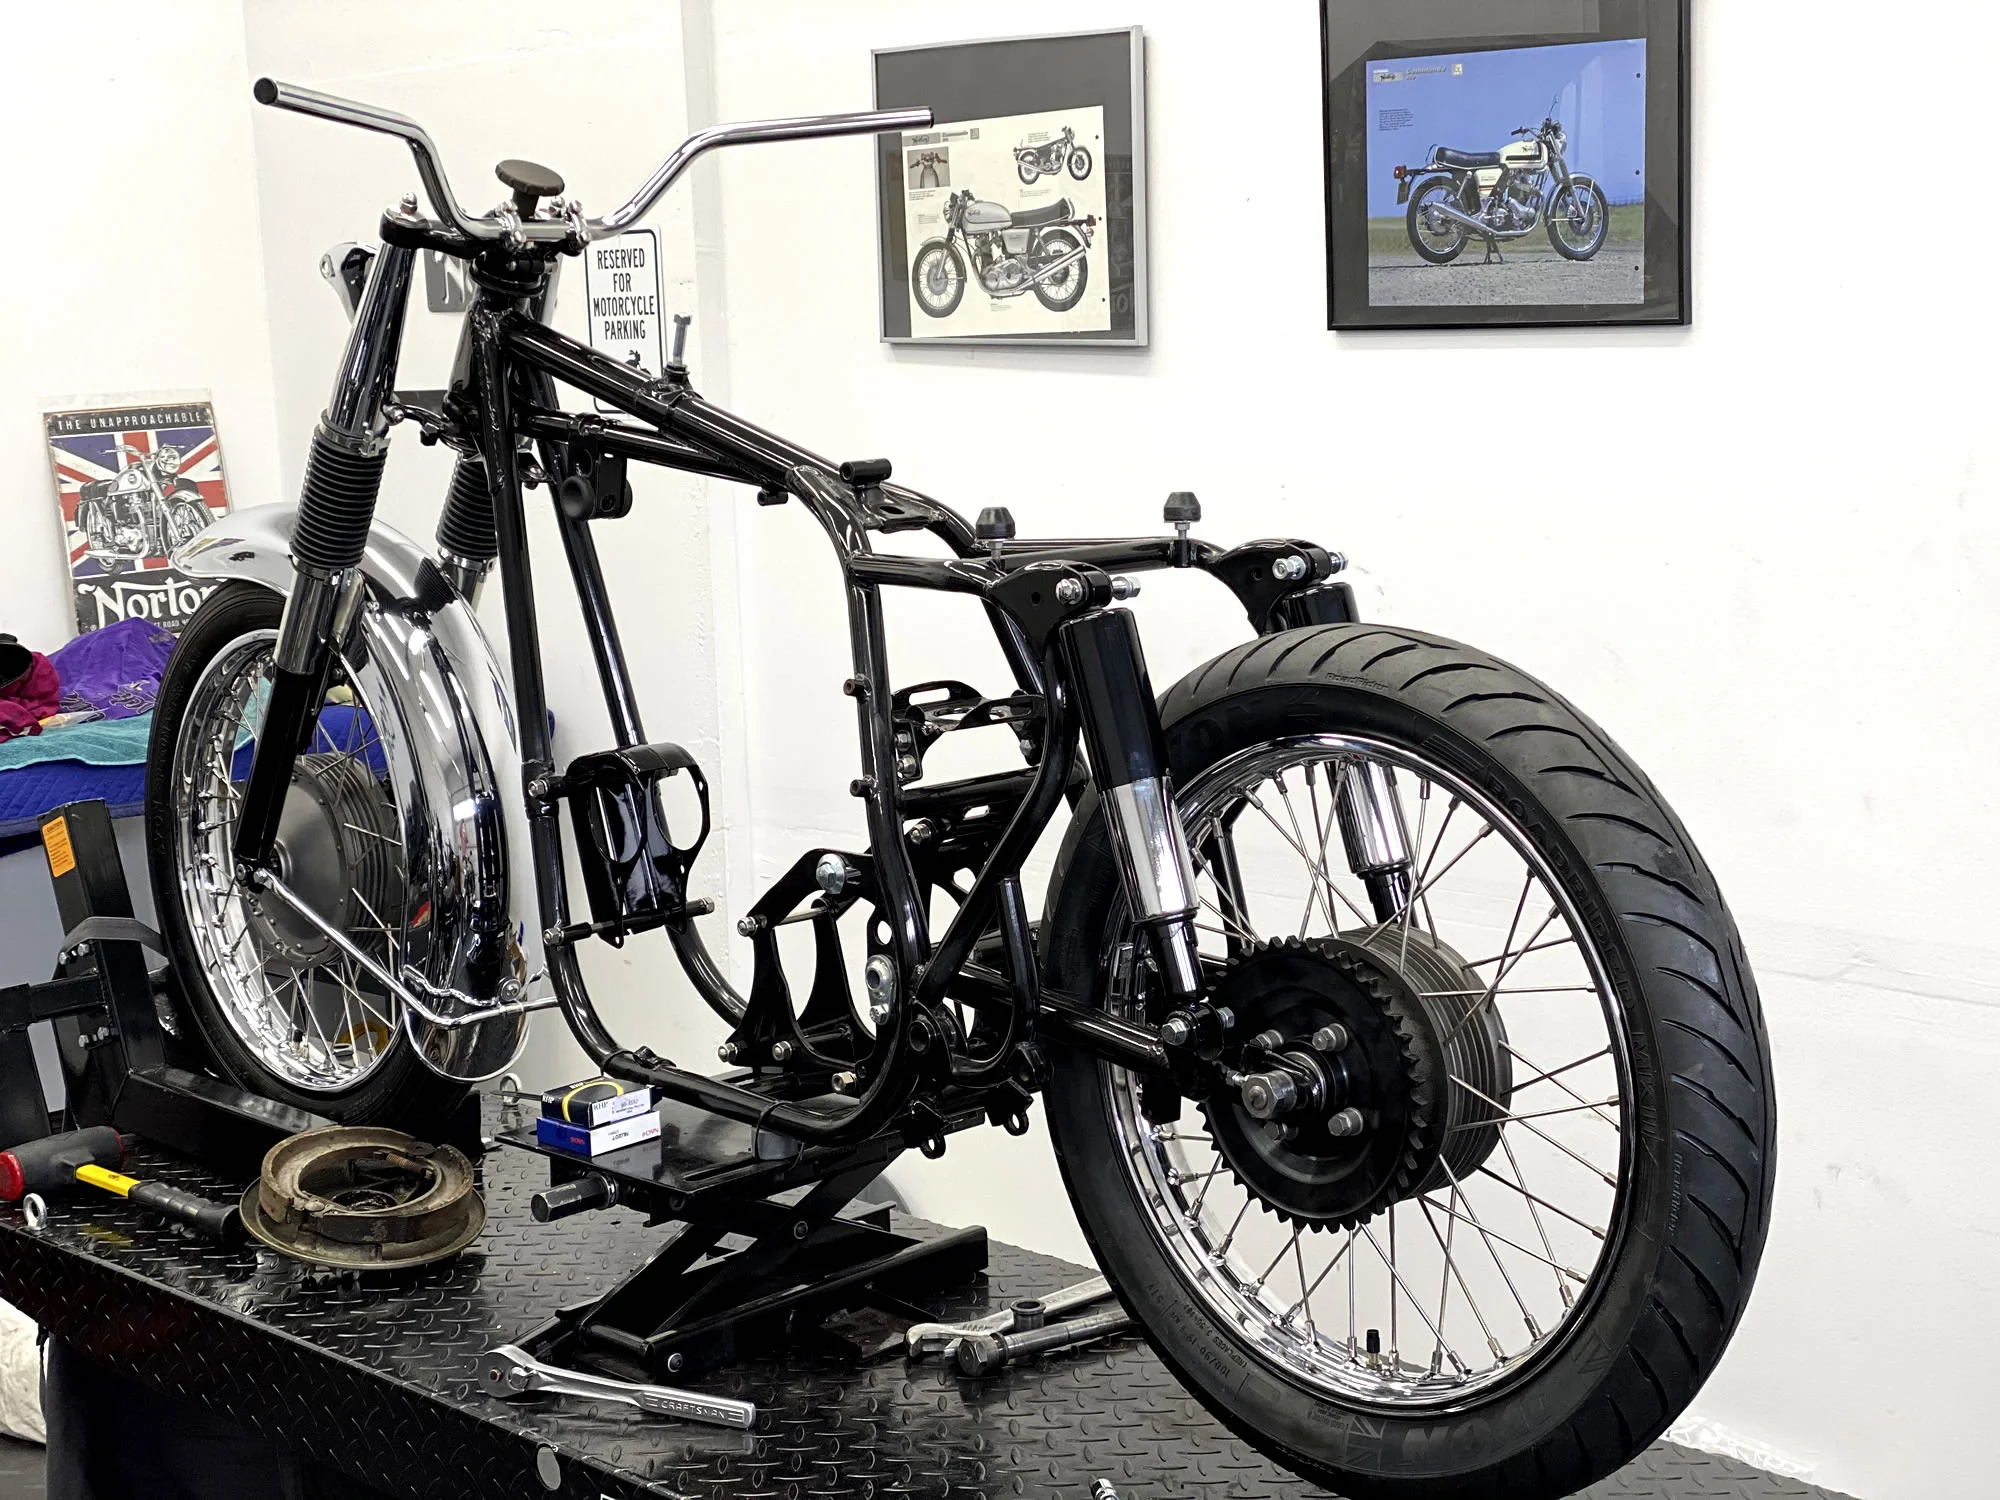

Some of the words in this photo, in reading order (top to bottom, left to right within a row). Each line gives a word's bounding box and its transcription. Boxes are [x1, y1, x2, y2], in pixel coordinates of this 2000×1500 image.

[597, 248, 645, 270] RESERVED
[613, 273, 632, 292] FOR
[593, 295, 655, 317] MOTORCYCLE
[604, 320, 646, 340] PARKING
[58, 419, 81, 431] THE
[90, 411, 202, 430] UNAPPROACHABLE
[162, 621, 180, 629] ROAD
[1212, 1336, 1248, 1369] (REPLACES
[661, 1400, 725, 1419] CRAFTSMAN
